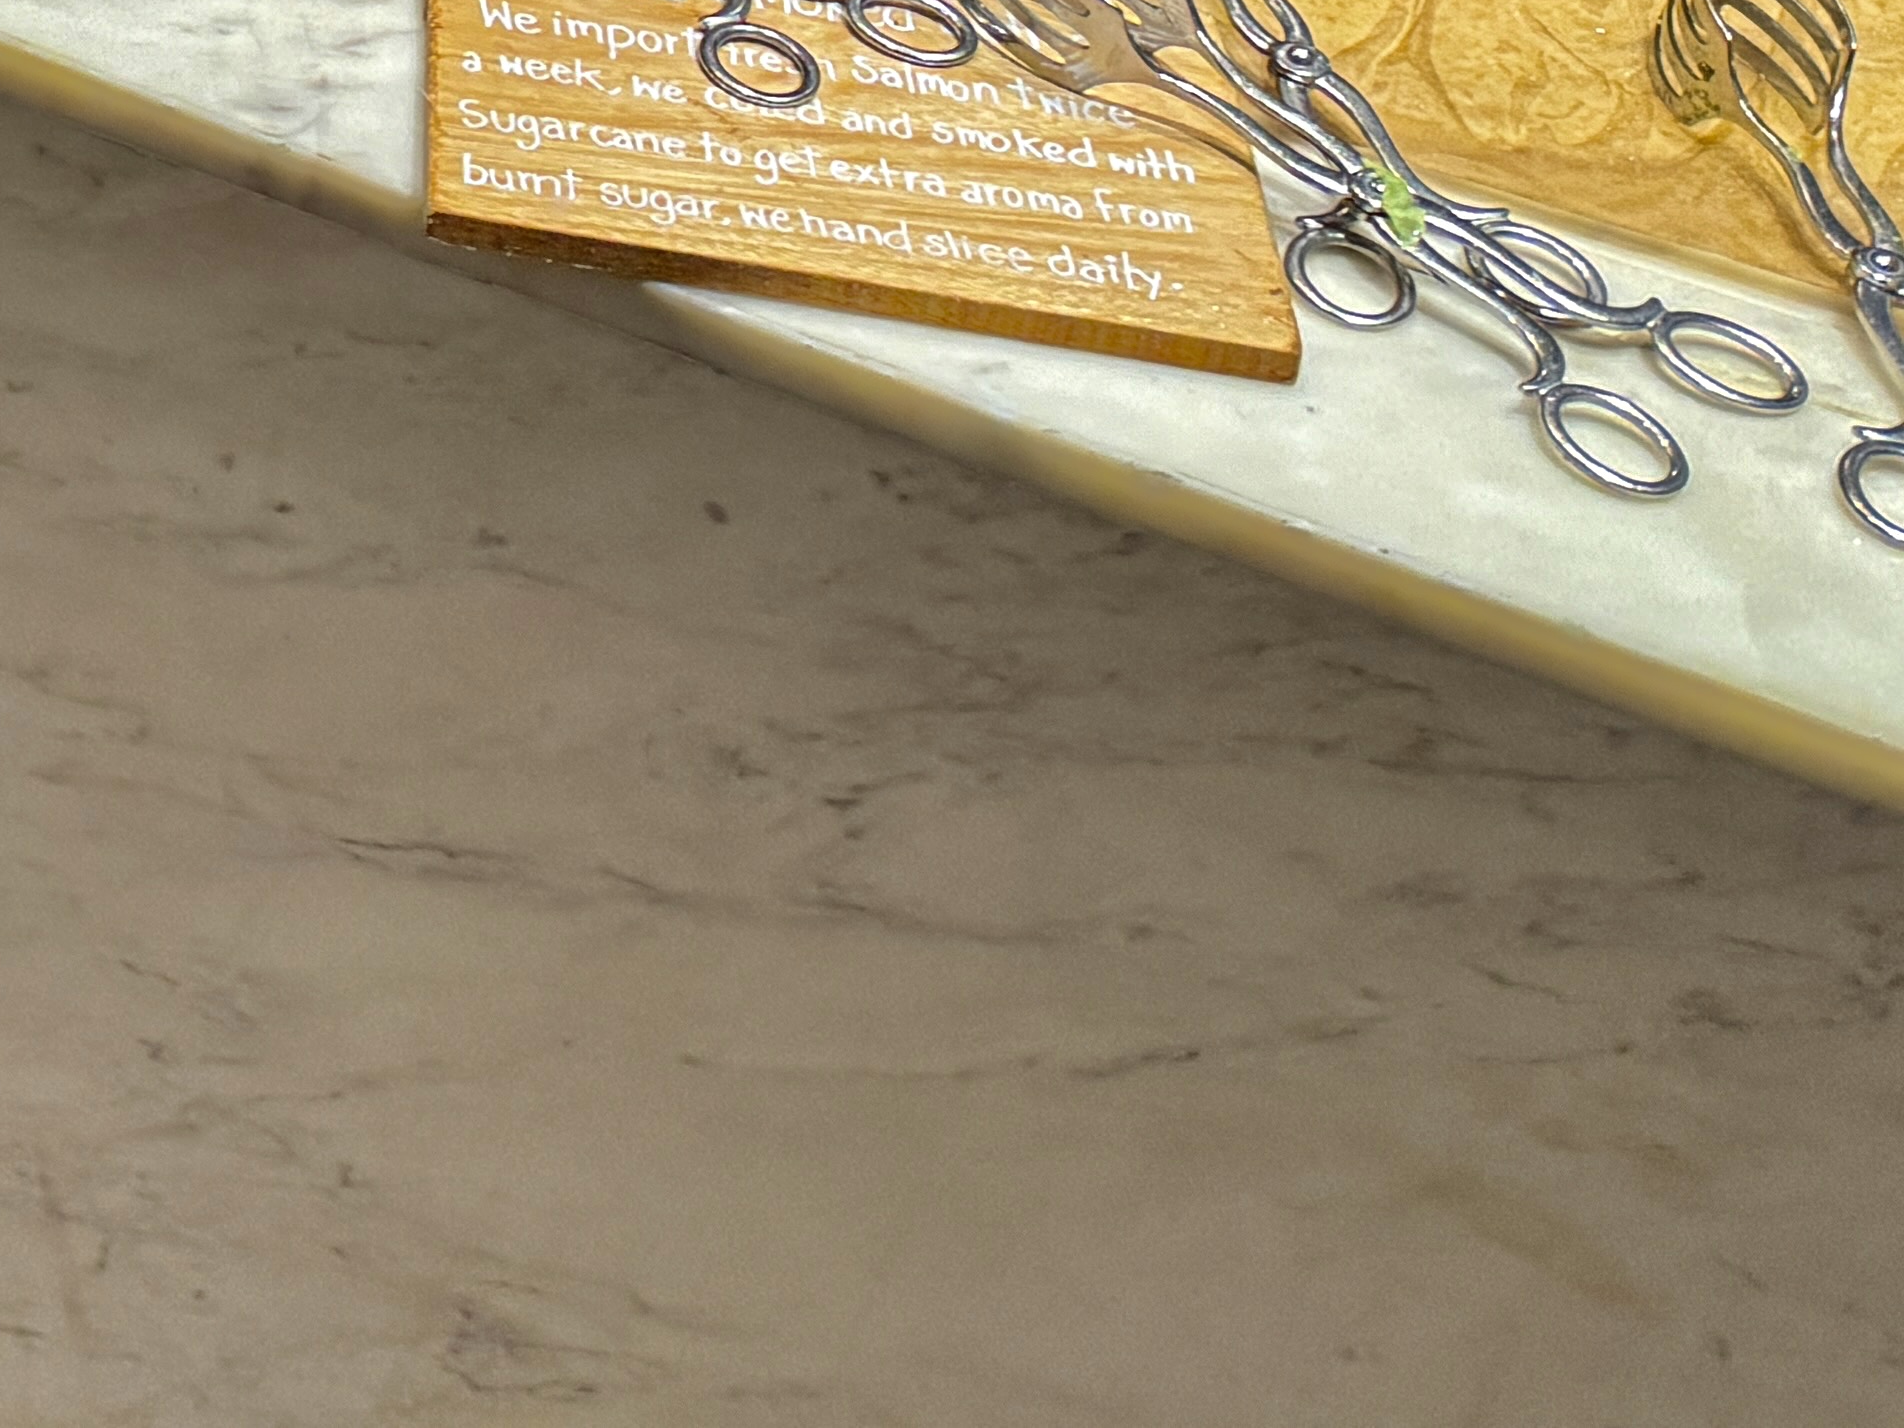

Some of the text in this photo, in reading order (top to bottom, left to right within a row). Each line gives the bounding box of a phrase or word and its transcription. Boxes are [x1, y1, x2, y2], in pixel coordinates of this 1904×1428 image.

[552, 10, 703, 60] import
[851, 54, 1001, 111] Salmon
[461, 50, 483, 74] a
[632, 76, 688, 105] we
[841, 109, 914, 140] and
[932, 120, 1097, 168] smoked
[1108, 147, 1196, 185] with
[462, 152, 584, 201] burnt
[739, 204, 793, 233] we
[799, 207, 913, 253] hand
[922, 230, 1034, 273] slice
[700, 130, 743, 167] to
[754, 144, 822, 186] get
[829, 158, 947, 199] extra
[961, 179, 1084, 221] aroma
[1094, 186, 1195, 234] from
